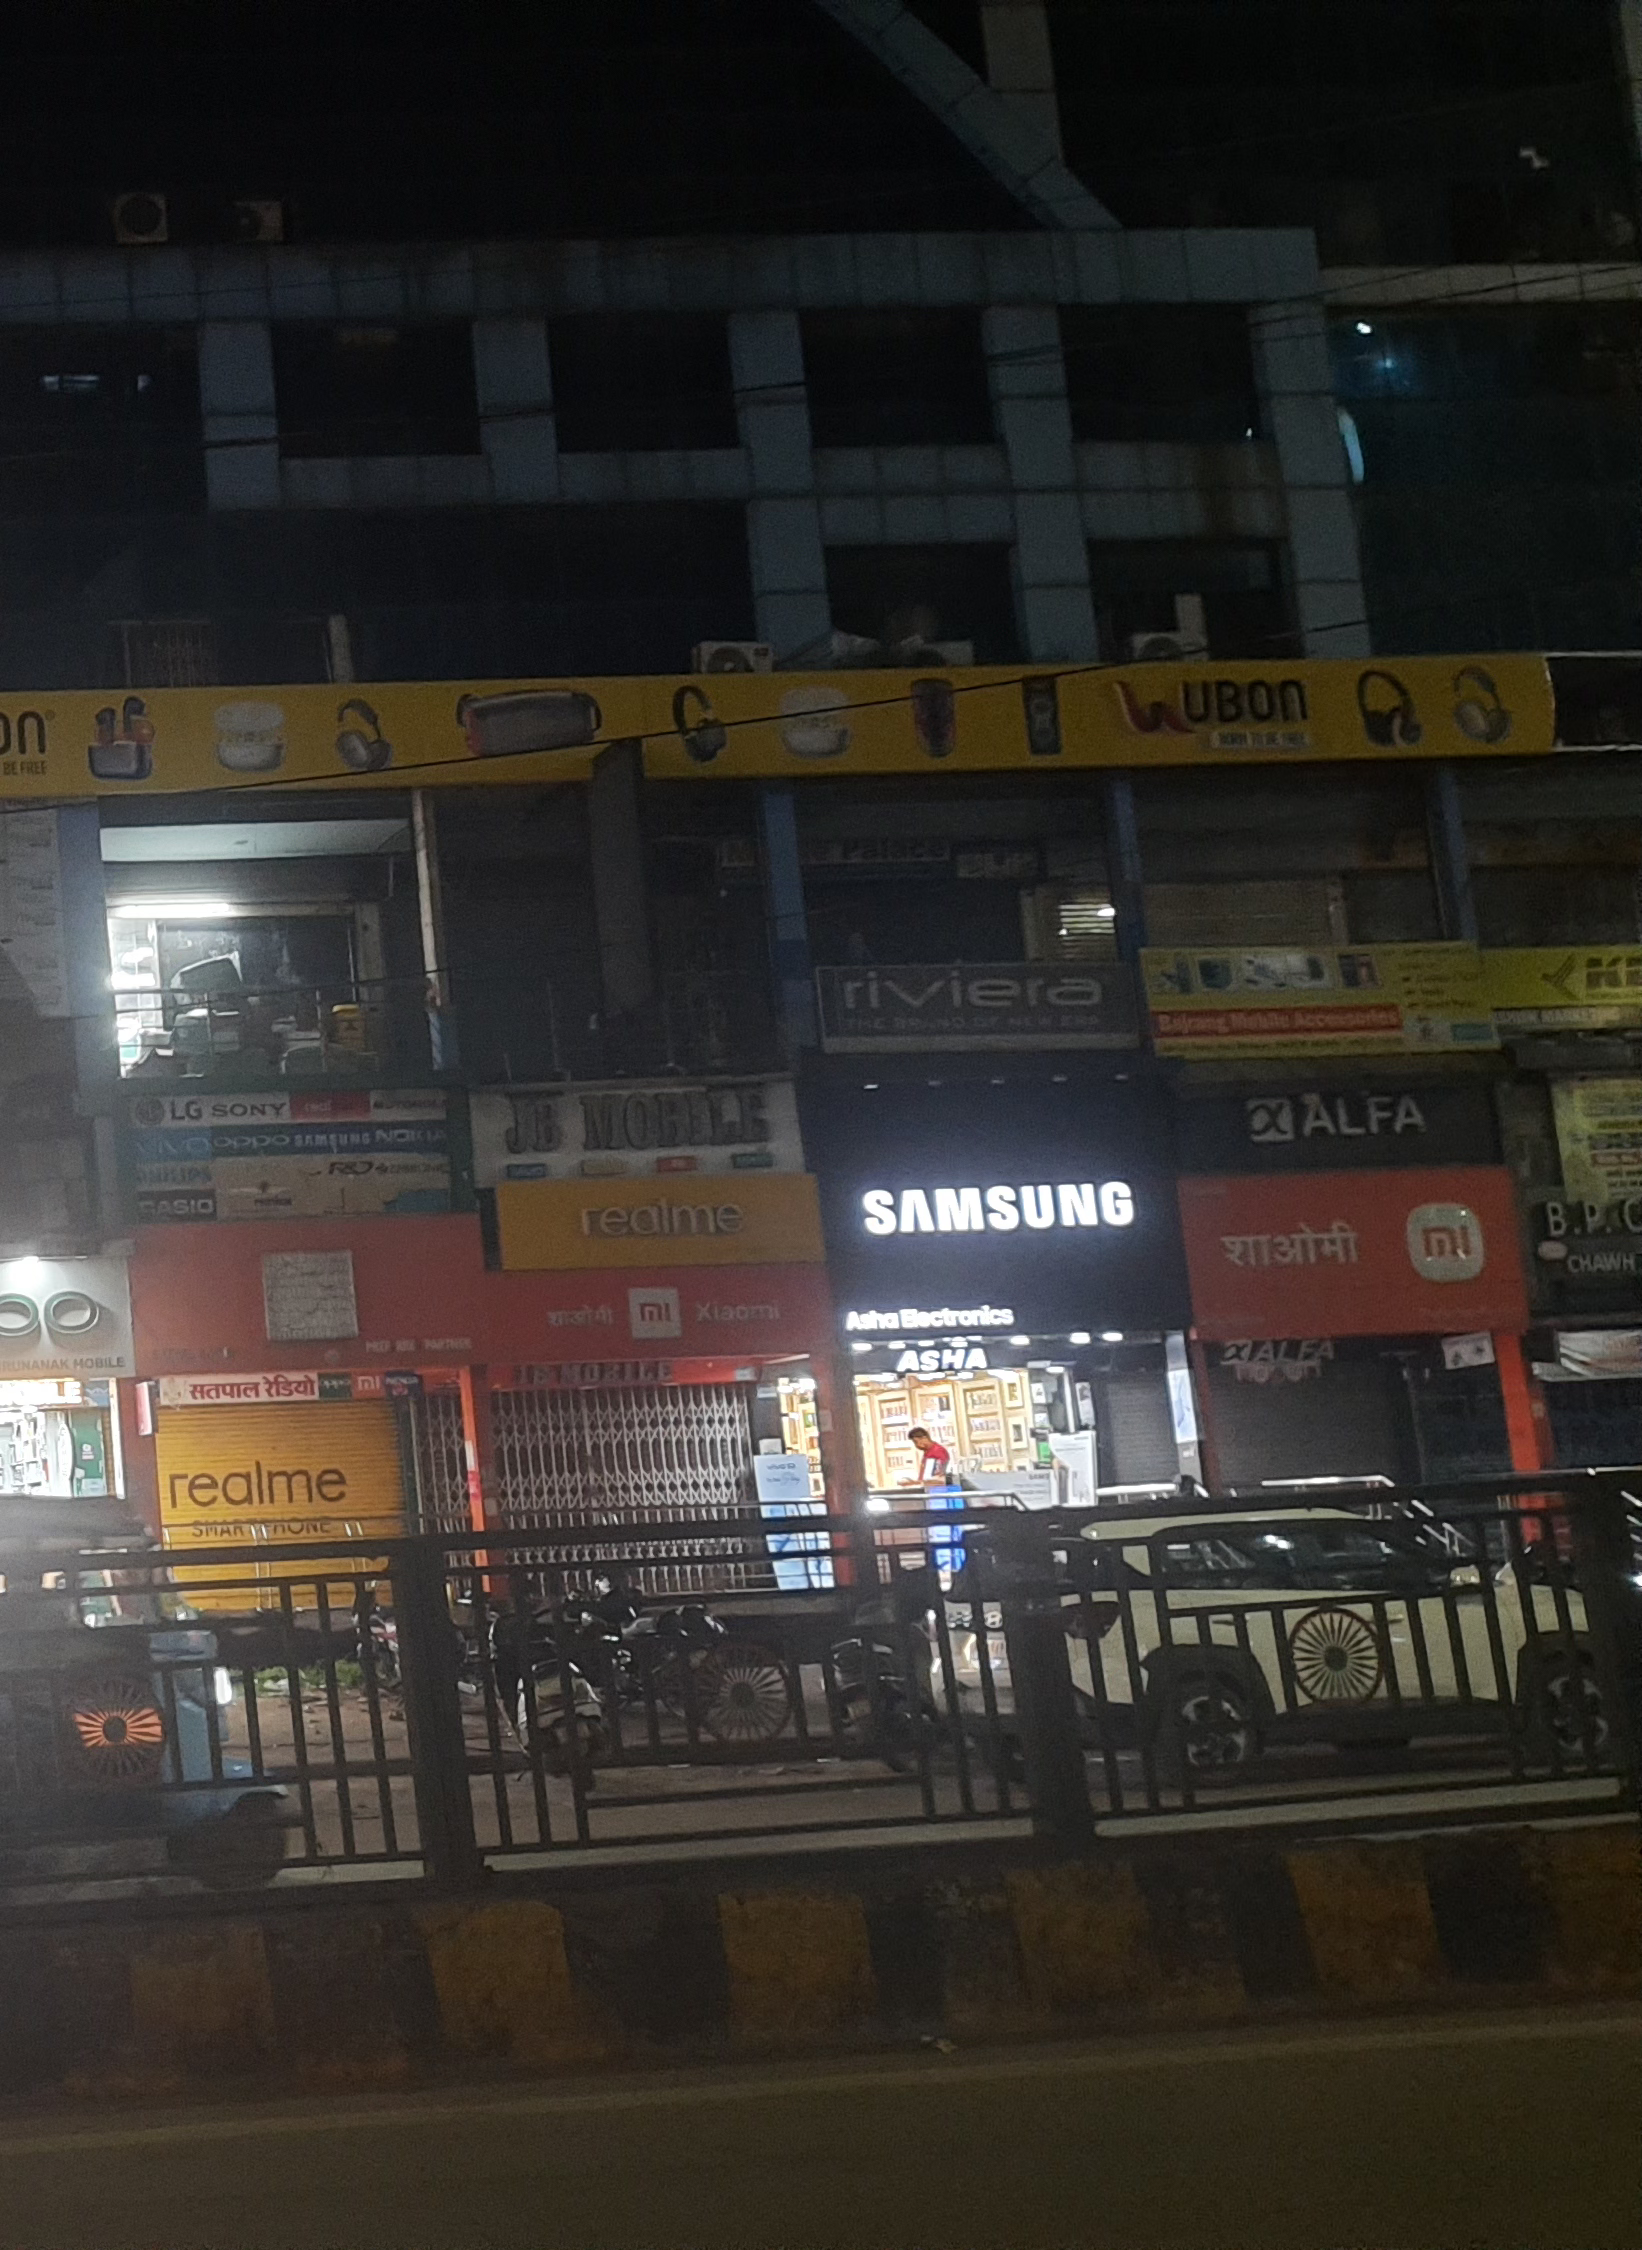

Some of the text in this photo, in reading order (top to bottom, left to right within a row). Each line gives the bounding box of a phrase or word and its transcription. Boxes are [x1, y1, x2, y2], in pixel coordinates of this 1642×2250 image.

[1182, 681, 1308, 724] UBON
[843, 970, 1101, 1008] riviera
[170, 1100, 203, 1121] LG
[211, 1102, 286, 1118] SONY
[1301, 1094, 1426, 1137] ALFA
[580, 1199, 744, 1236] realme
[862, 1181, 1135, 1236] SAMSUNG
[1220, 1220, 1360, 1267] शाओमी
[695, 1302, 780, 1323] Xiaomi
[846, 1305, 1014, 1331] Asha Electronics
[73, 1356, 125, 1369] MOBILE
[897, 1348, 988, 1372] ASHA
[189, 1380, 260, 1400] सतपाल
[264, 1375, 315, 1399] रेडियो
[169, 1461, 346, 1508] realme
